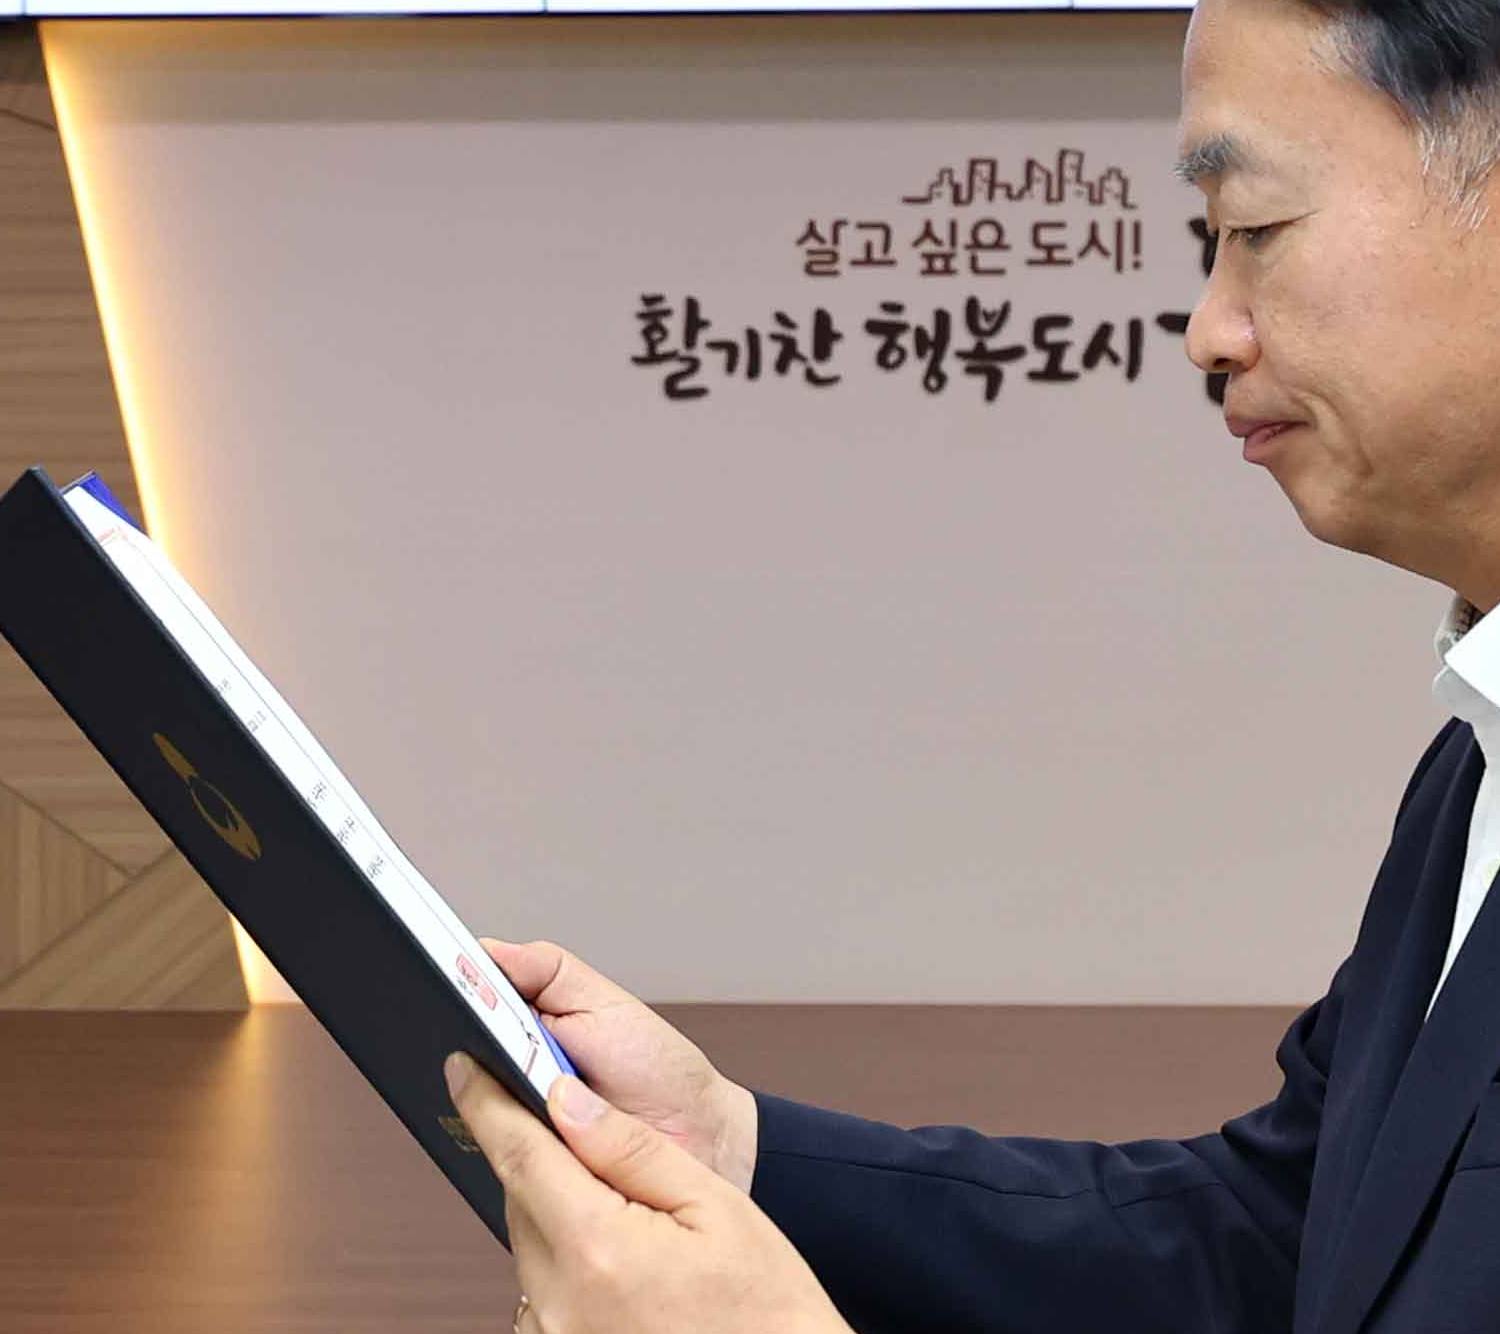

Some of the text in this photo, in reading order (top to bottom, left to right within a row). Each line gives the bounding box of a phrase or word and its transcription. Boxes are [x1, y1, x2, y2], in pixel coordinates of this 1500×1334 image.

[795, 218, 1144, 278] 살고 싶은 도시!
[631, 292, 843, 402] 활기찬
[864, 295, 1146, 403] 행복도시
